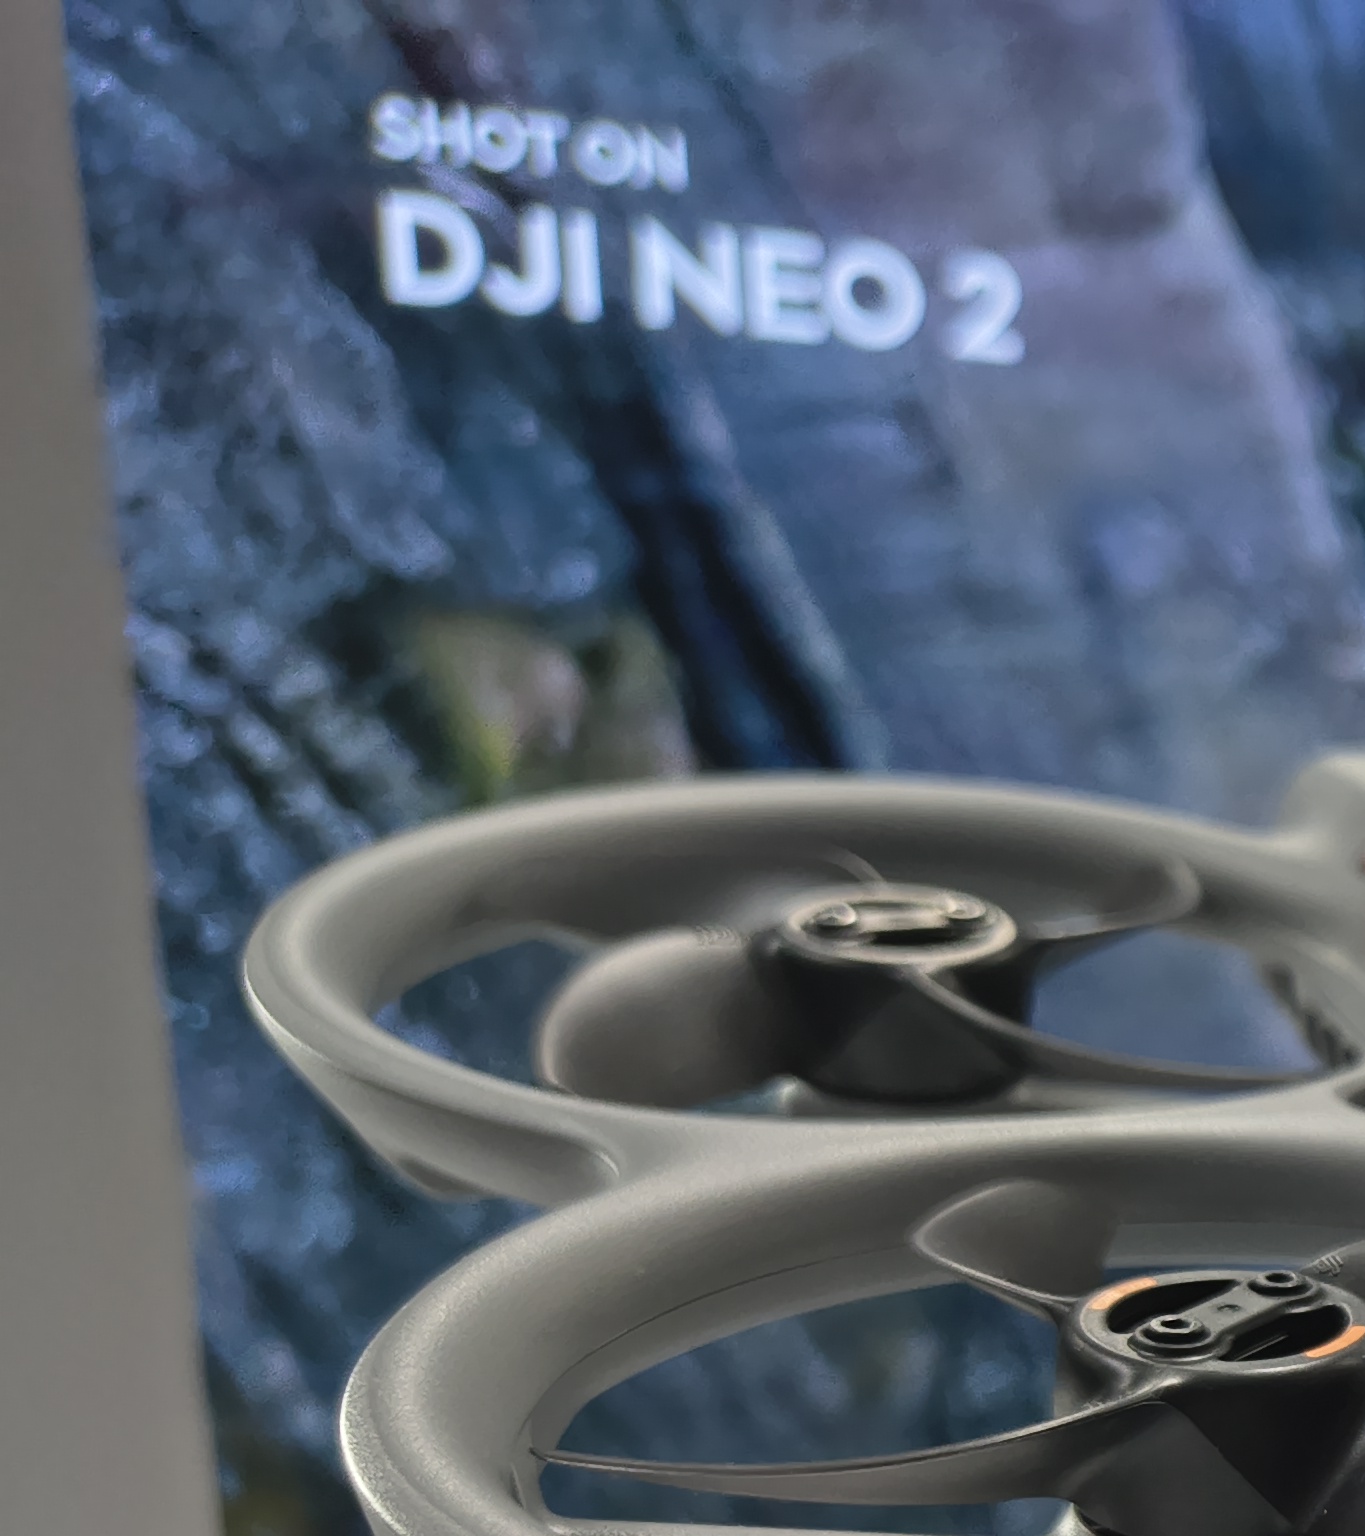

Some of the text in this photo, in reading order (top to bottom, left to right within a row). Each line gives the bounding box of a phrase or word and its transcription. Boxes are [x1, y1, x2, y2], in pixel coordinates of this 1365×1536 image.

[372, 93, 688, 191] SHOT ON
[379, 190, 1026, 363] DJI NEO 2
